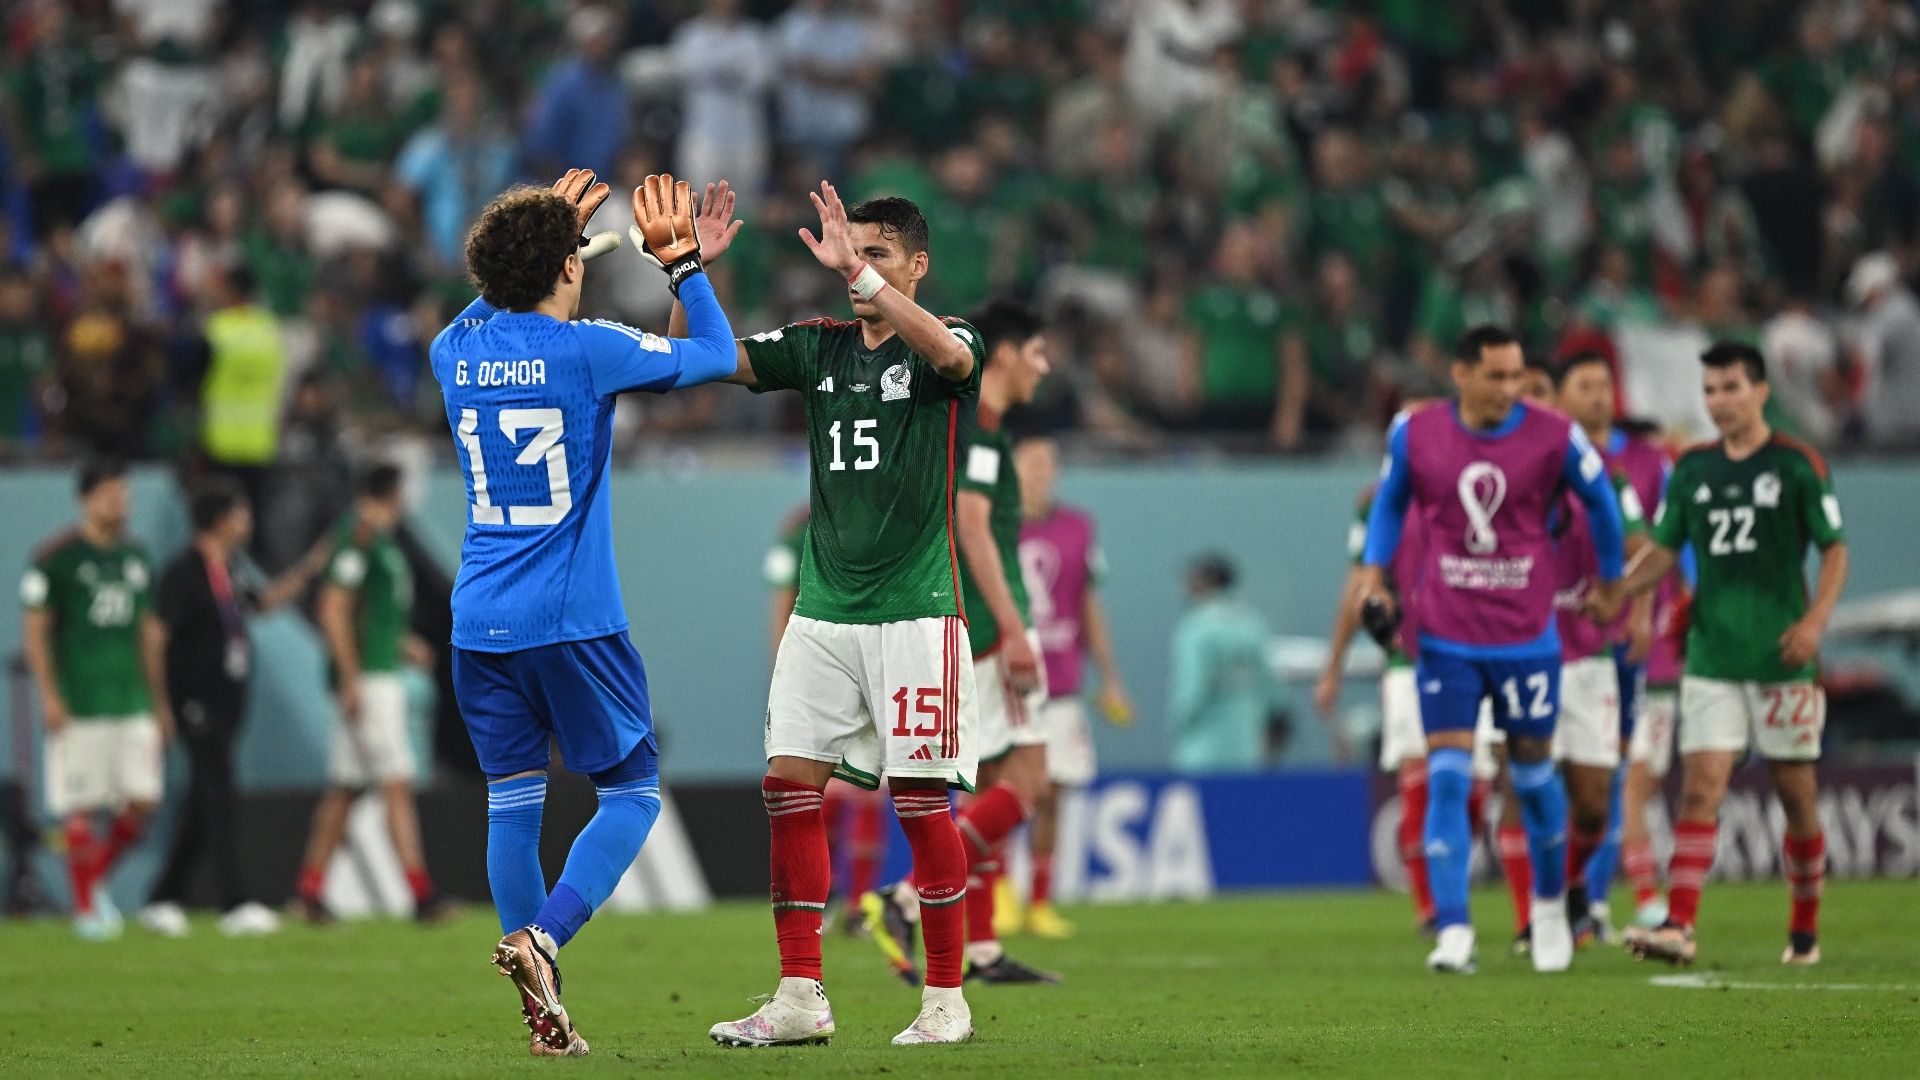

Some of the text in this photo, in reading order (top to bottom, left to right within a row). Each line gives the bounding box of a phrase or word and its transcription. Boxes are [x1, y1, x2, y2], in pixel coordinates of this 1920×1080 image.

[456, 359, 546, 386] G. OCHOA
[458, 408, 573, 525] 13
[828, 419, 880, 471] 15
[1708, 506, 1757, 556] 22
[892, 687, 942, 737] 15
[1503, 671, 1553, 720] 12
[1764, 687, 1817, 728] 22
